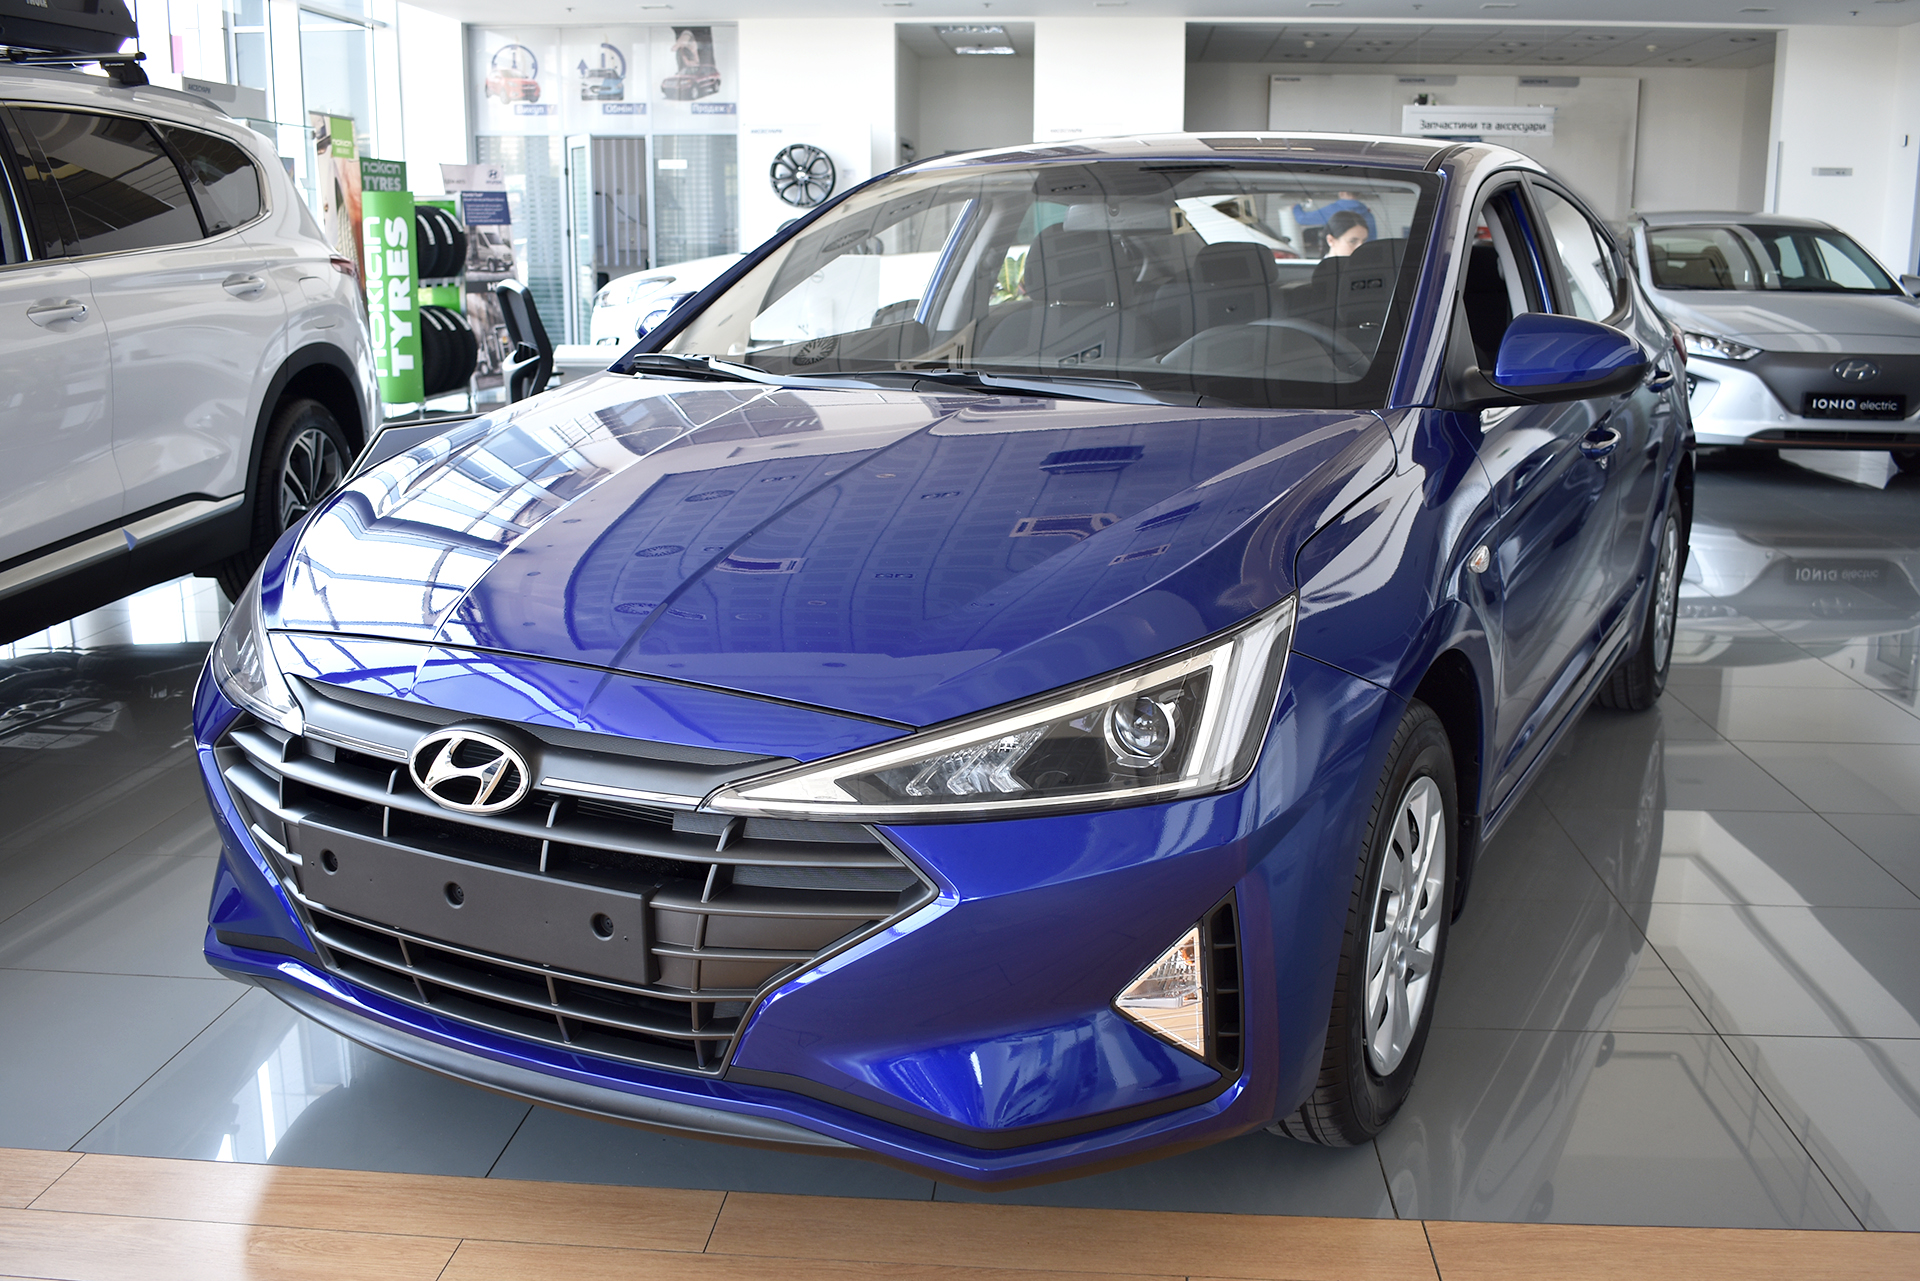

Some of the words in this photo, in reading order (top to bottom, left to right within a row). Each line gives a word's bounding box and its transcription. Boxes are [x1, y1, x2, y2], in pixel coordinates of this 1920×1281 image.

[605, 103, 633, 114] Обмін
[1420, 119, 1478, 130] Запчастини
[1481, 122, 1492, 130] та
[1495, 122, 1546, 133] аксесуари
[363, 176, 402, 191] TYRES
[384, 216, 414, 377] TYRES
[1812, 398, 1856, 410] IONIQ
[1860, 400, 1898, 411] electric
